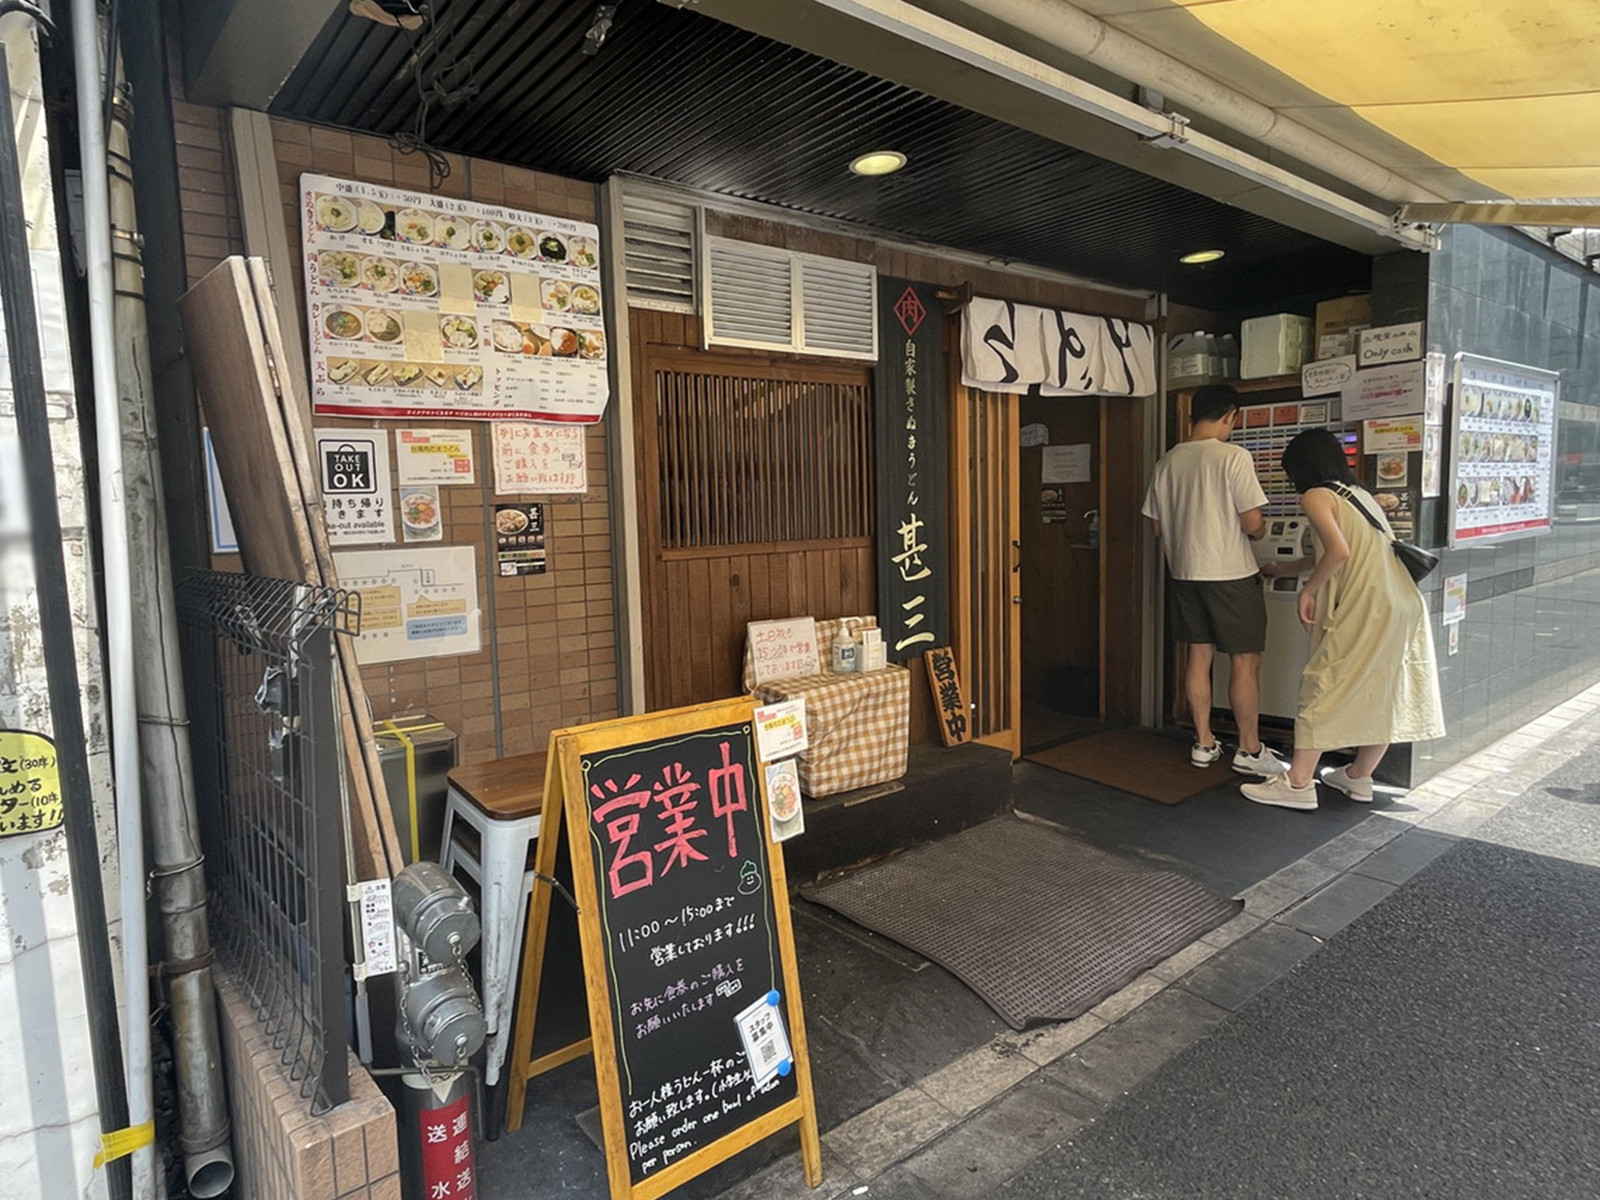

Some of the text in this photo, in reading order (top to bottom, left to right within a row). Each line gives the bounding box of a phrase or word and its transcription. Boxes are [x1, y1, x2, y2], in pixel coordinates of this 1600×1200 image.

[310, 302, 324, 356] カレーうどん
[1363, 342, 1414, 361] Only cash
[314, 360, 327, 398] 天ぷら
[904, 338, 918, 507] 自家製さぬきうどん
[333, 454, 361, 464] TAKE
[333, 473, 365, 488] OK
[334, 463, 362, 472] OUT
[324, 509, 384, 520] きます
[353, 520, 386, 530] available
[891, 513, 935, 651] 甚三
[932, 650, 967, 742] 営業中
[590, 741, 749, 900] 営業中
[629, 958, 745, 1018] お先に食券のご購入を
[634, 992, 736, 1040] お願いいたします
[628, 1134, 666, 1162] Please
[670, 1117, 699, 1139] order
[702, 1110, 721, 1125] one
[721, 1092, 743, 1115] bowl
[452, 1110, 473, 1200] 連結送
[641, 1157, 658, 1175] per
